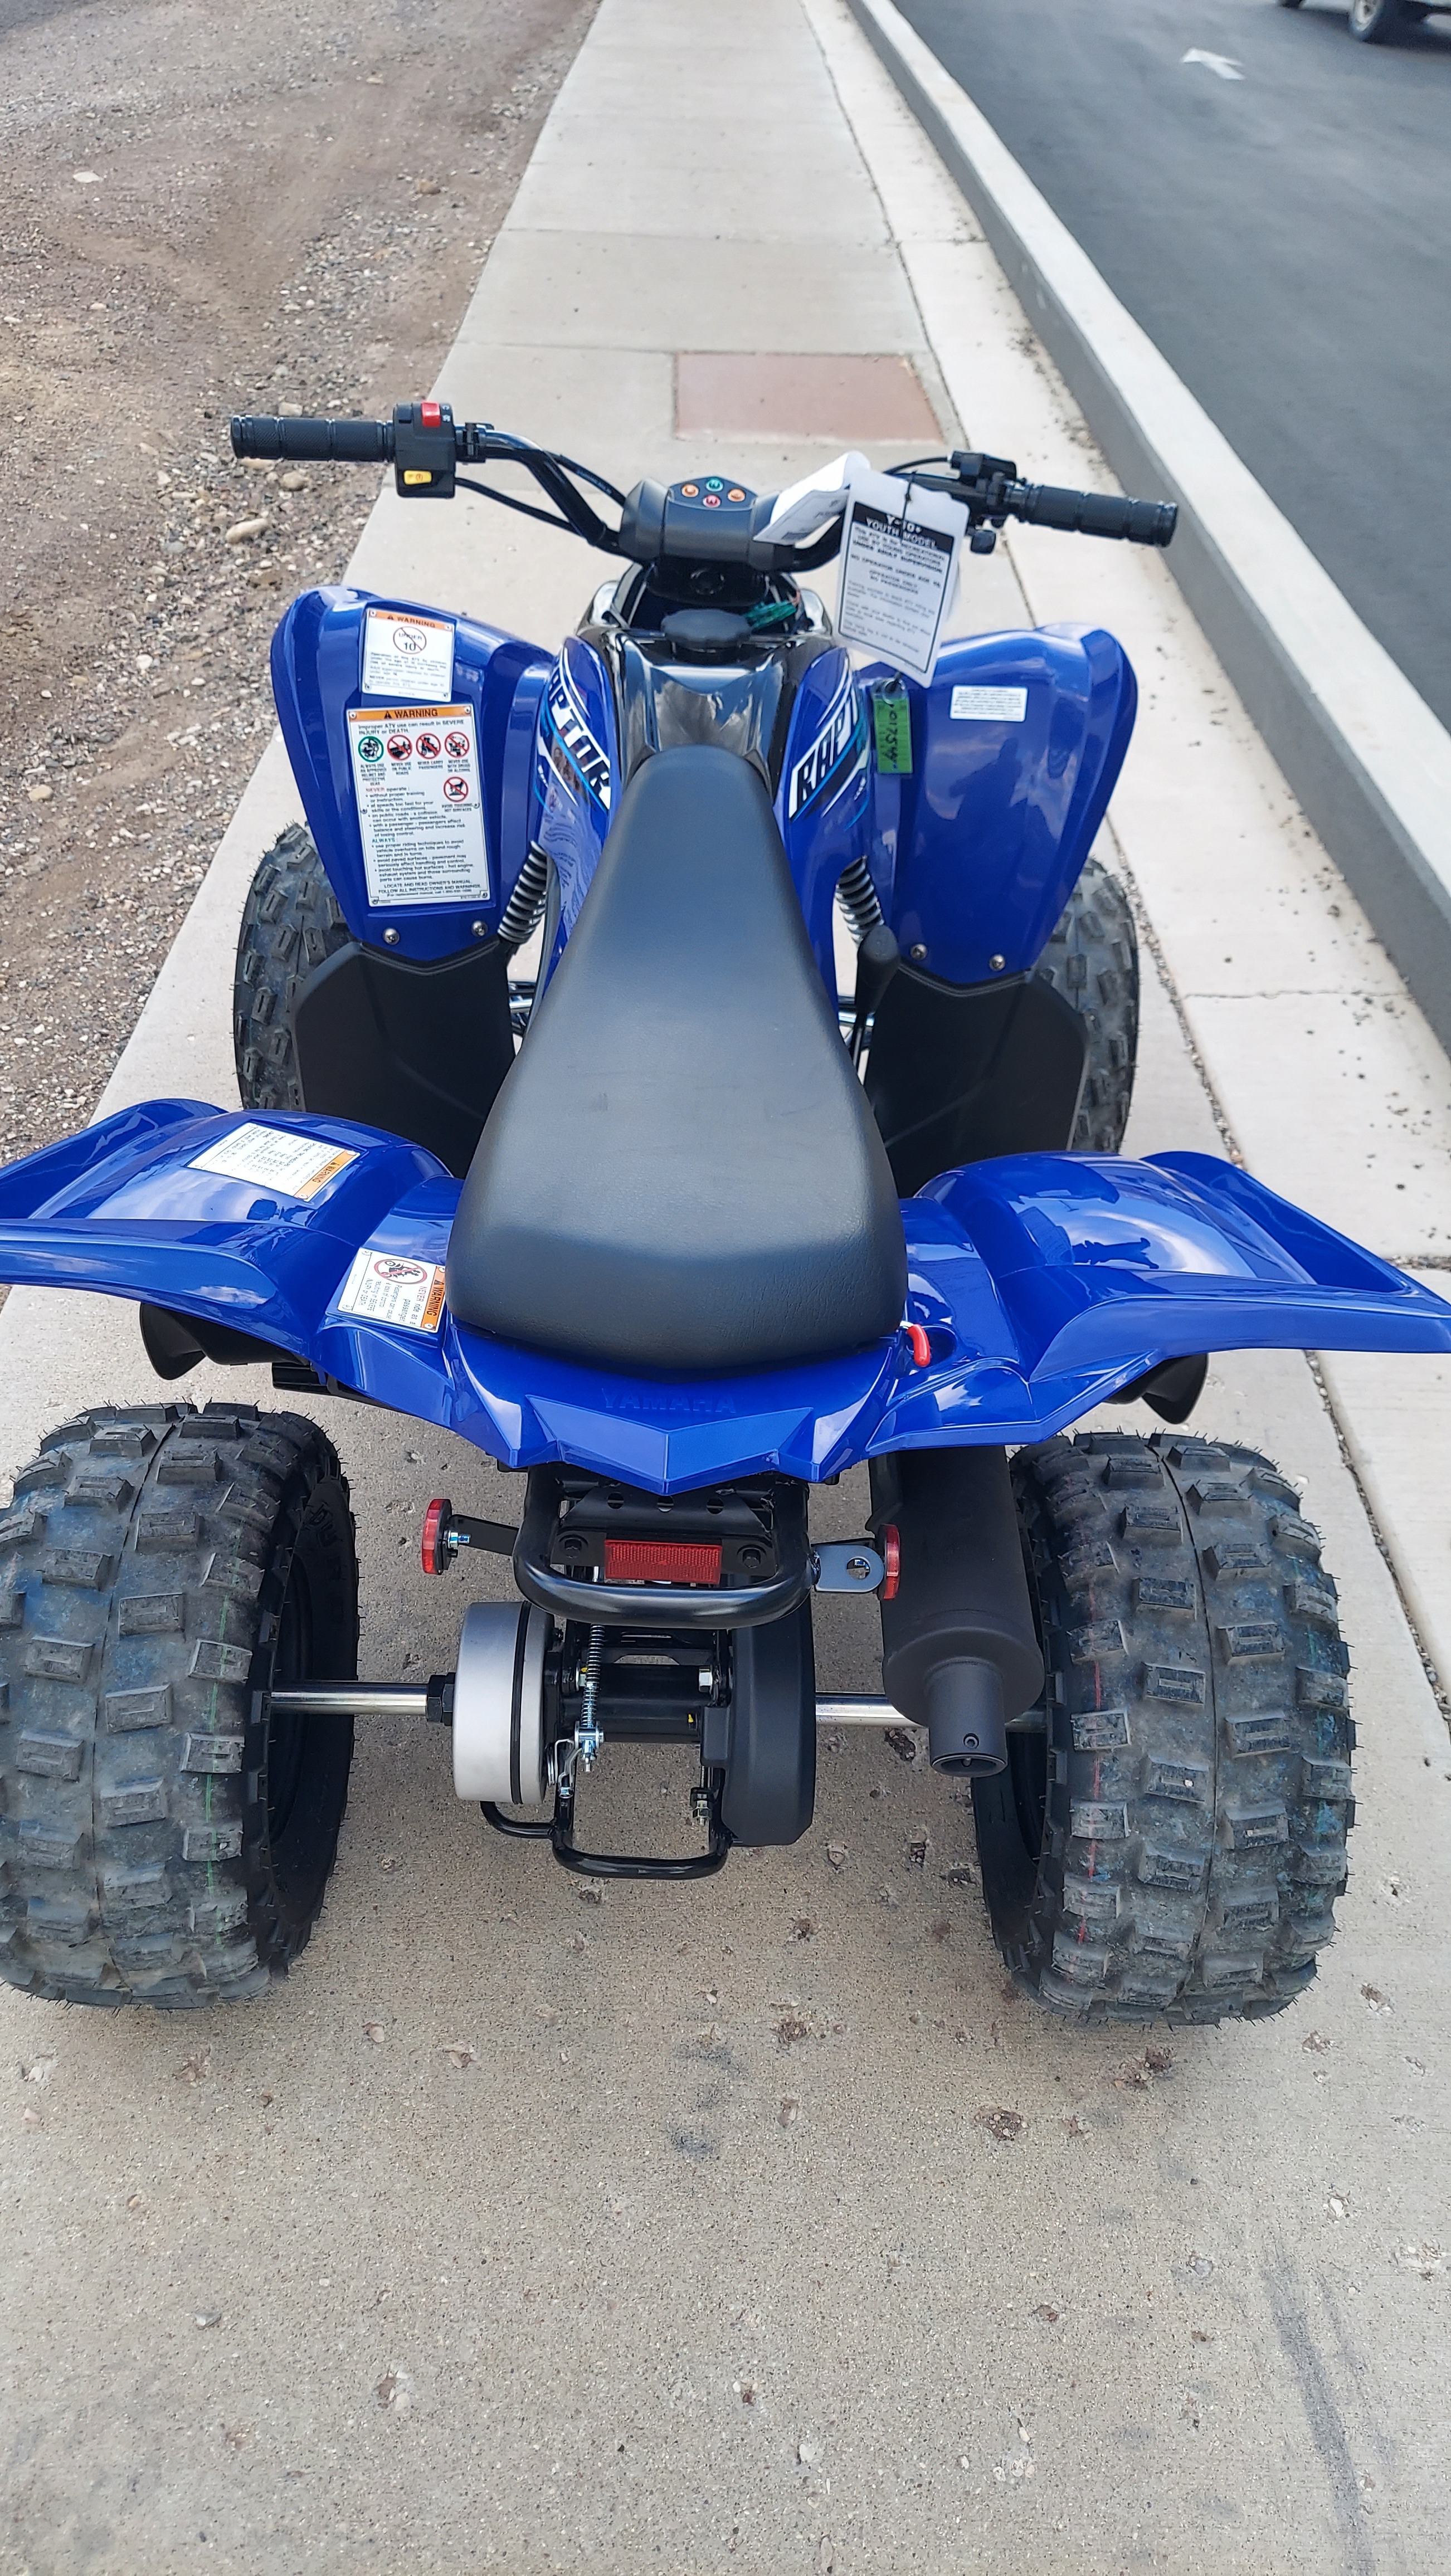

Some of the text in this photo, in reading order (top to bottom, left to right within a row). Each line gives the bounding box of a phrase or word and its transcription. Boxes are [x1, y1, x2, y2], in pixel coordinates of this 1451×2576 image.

[866, 517, 936, 548] YOUTH MODEL
[397, 616, 435, 628] WARNING
[405, 642, 416, 651] 10
[394, 708, 439, 719] WARNING
[310, 1165, 336, 1183] WARNING
[363, 1277, 373, 1290] INJURY
[371, 1280, 382, 1294] resulting
[389, 1284, 402, 1303] Passengers
[416, 1285, 427, 1302] NEVER
[427, 1285, 445, 1316] WARNING
[367, 1297, 377, 1312] SEVERE
[378, 1296, 387, 1308] control
[412, 1302, 422, 1313] ride
[385, 1309, 393, 1319] cause
[601, 1388, 737, 1414] YAMAHA
